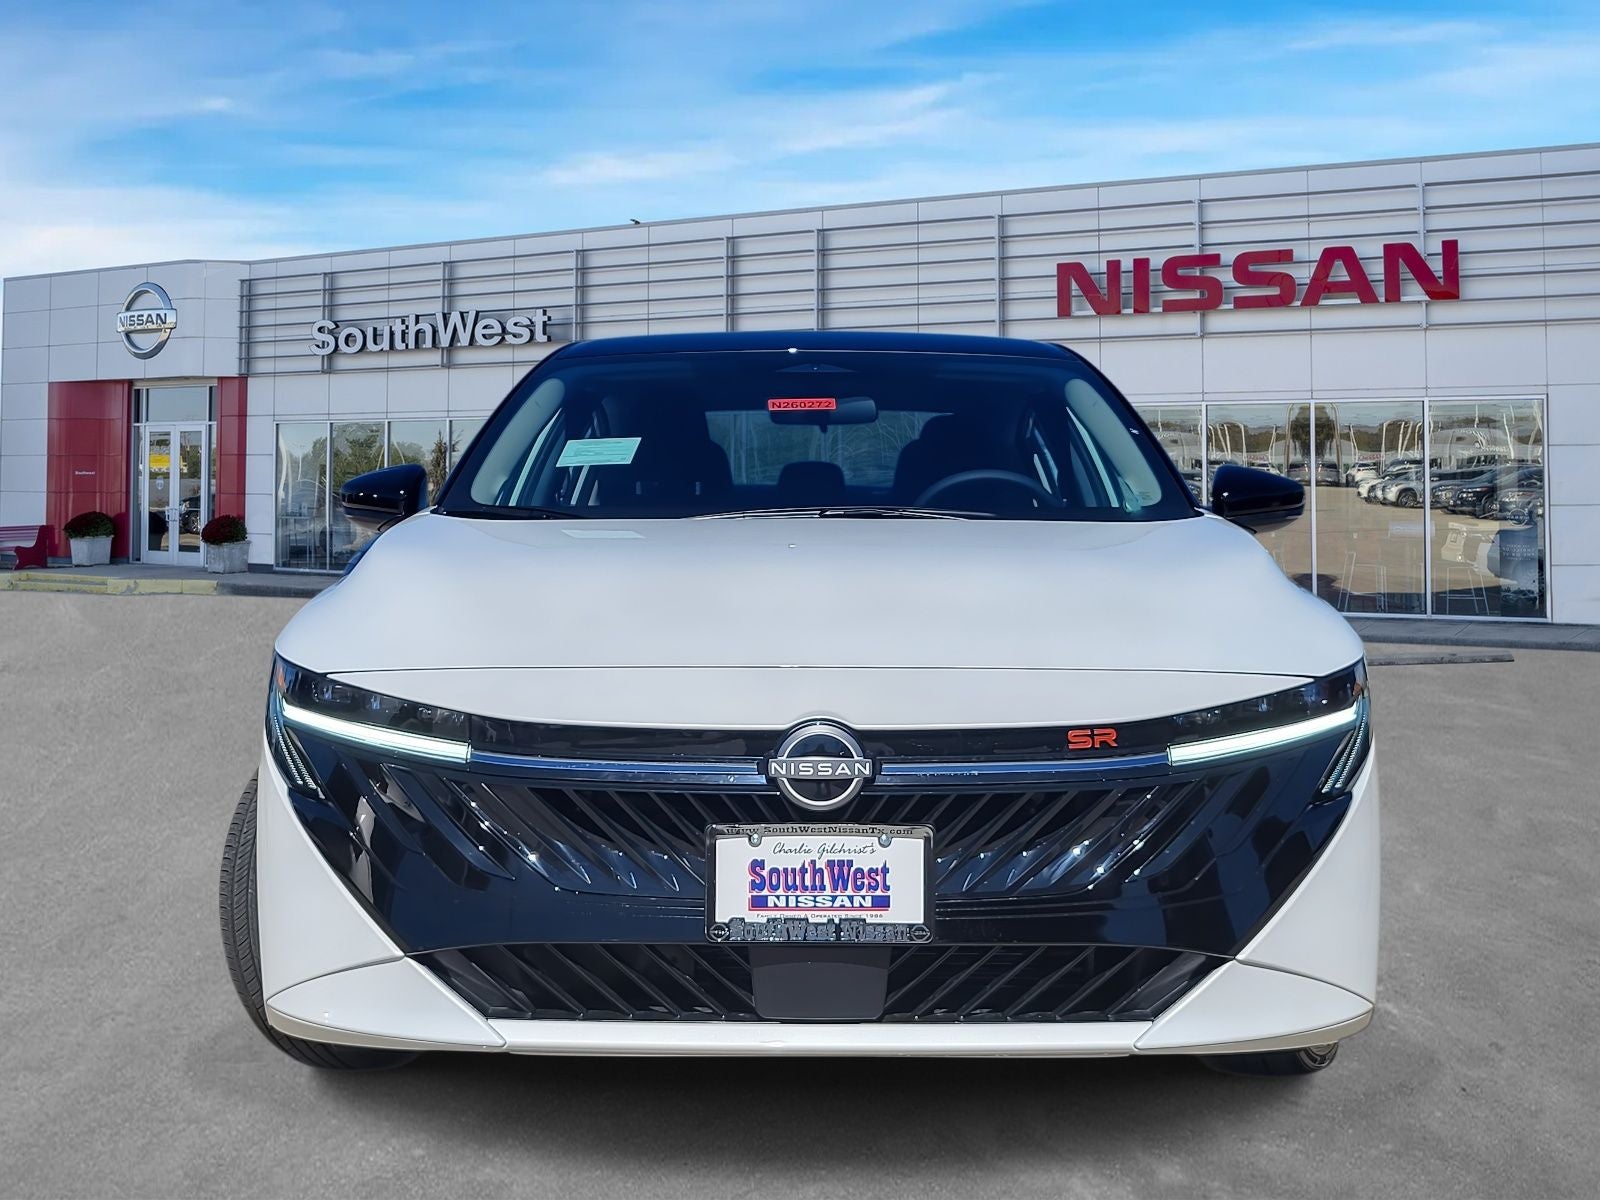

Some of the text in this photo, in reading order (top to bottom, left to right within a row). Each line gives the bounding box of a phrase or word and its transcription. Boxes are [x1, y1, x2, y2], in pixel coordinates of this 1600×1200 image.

[1056, 239, 1460, 317] NISSAN
[119, 312, 168, 328] NISSAN
[309, 308, 551, 357] SouthWest
[771, 400, 833, 409] N260272
[1067, 728, 1118, 749] SR
[771, 762, 870, 776] NISSAN
[726, 826, 913, 835] wwwSouthWestNissanTxcom
[772, 841, 877, 860] Charlie Gilchrist's
[748, 858, 891, 894] SouthWest
[767, 895, 872, 908] NISSAN
